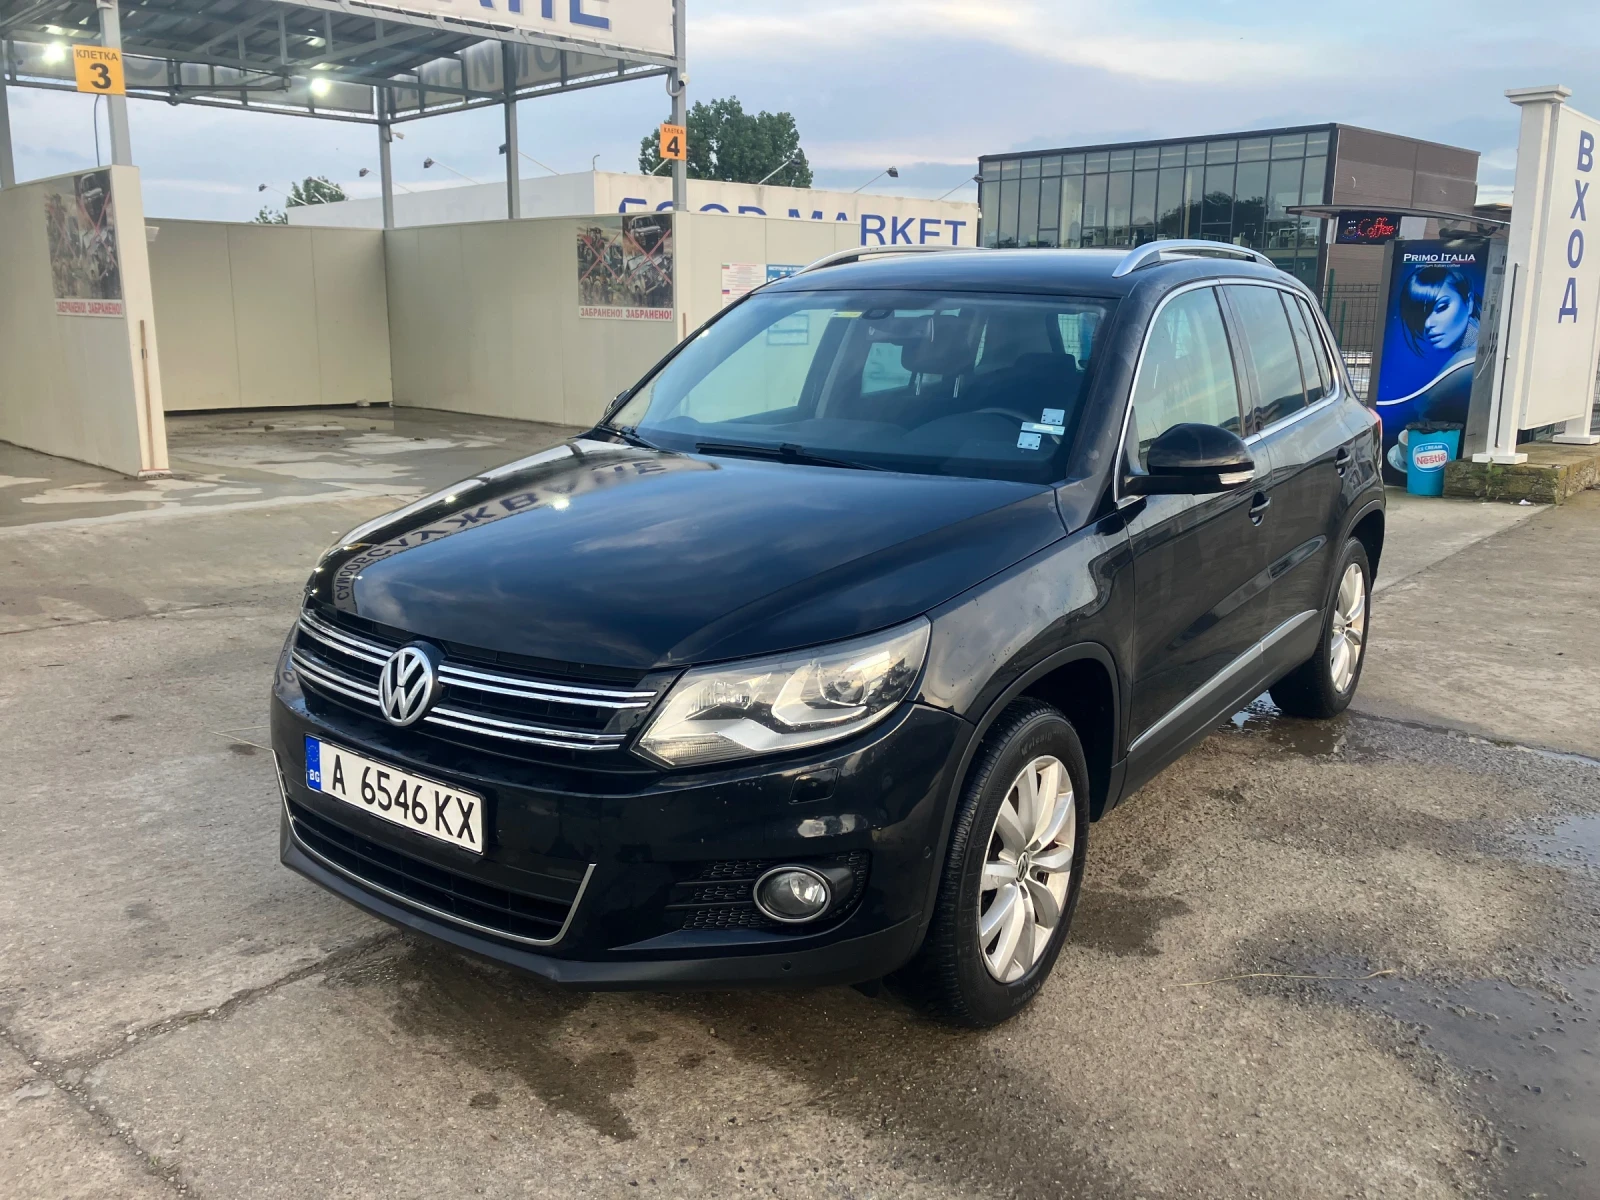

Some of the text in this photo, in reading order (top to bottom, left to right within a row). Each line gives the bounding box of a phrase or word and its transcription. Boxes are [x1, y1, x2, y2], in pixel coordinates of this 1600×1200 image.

[75, 49, 119, 61] КЛЕТКА
[89, 63, 112, 89] 3
[666, 136, 680, 157] 4
[1358, 216, 1394, 238] Coffee
[1558, 130, 1595, 324] ВХОД
[1403, 253, 1476, 262] PRIMO ITALIA
[580, 307, 672, 320] ЗАБРАНЕНО! ЗАБРАНЕНО!
[309, 771, 320, 782] BG
[331, 753, 346, 796] A
